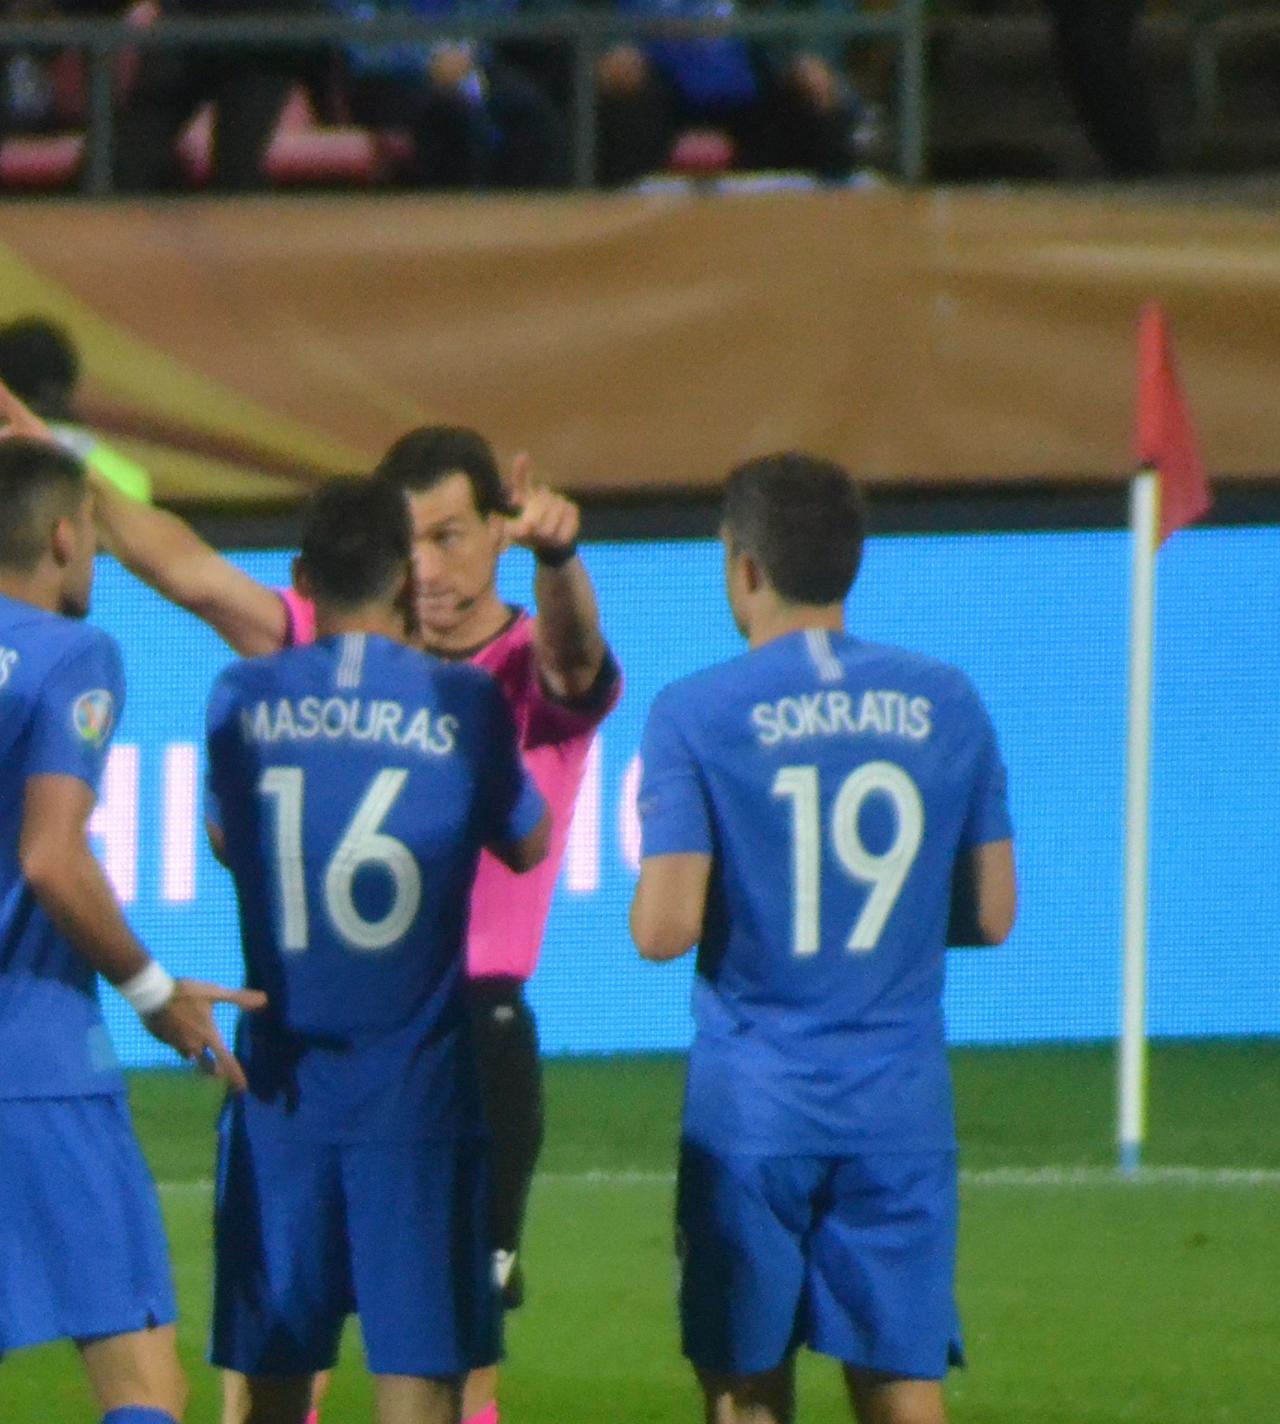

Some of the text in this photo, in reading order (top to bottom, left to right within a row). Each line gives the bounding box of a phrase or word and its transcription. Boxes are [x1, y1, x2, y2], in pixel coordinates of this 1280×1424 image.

[243, 697, 458, 754] MASOURAS
[752, 689, 931, 744] SOKRATIS
[258, 766, 422, 951] 16
[771, 760, 925, 956] 19
